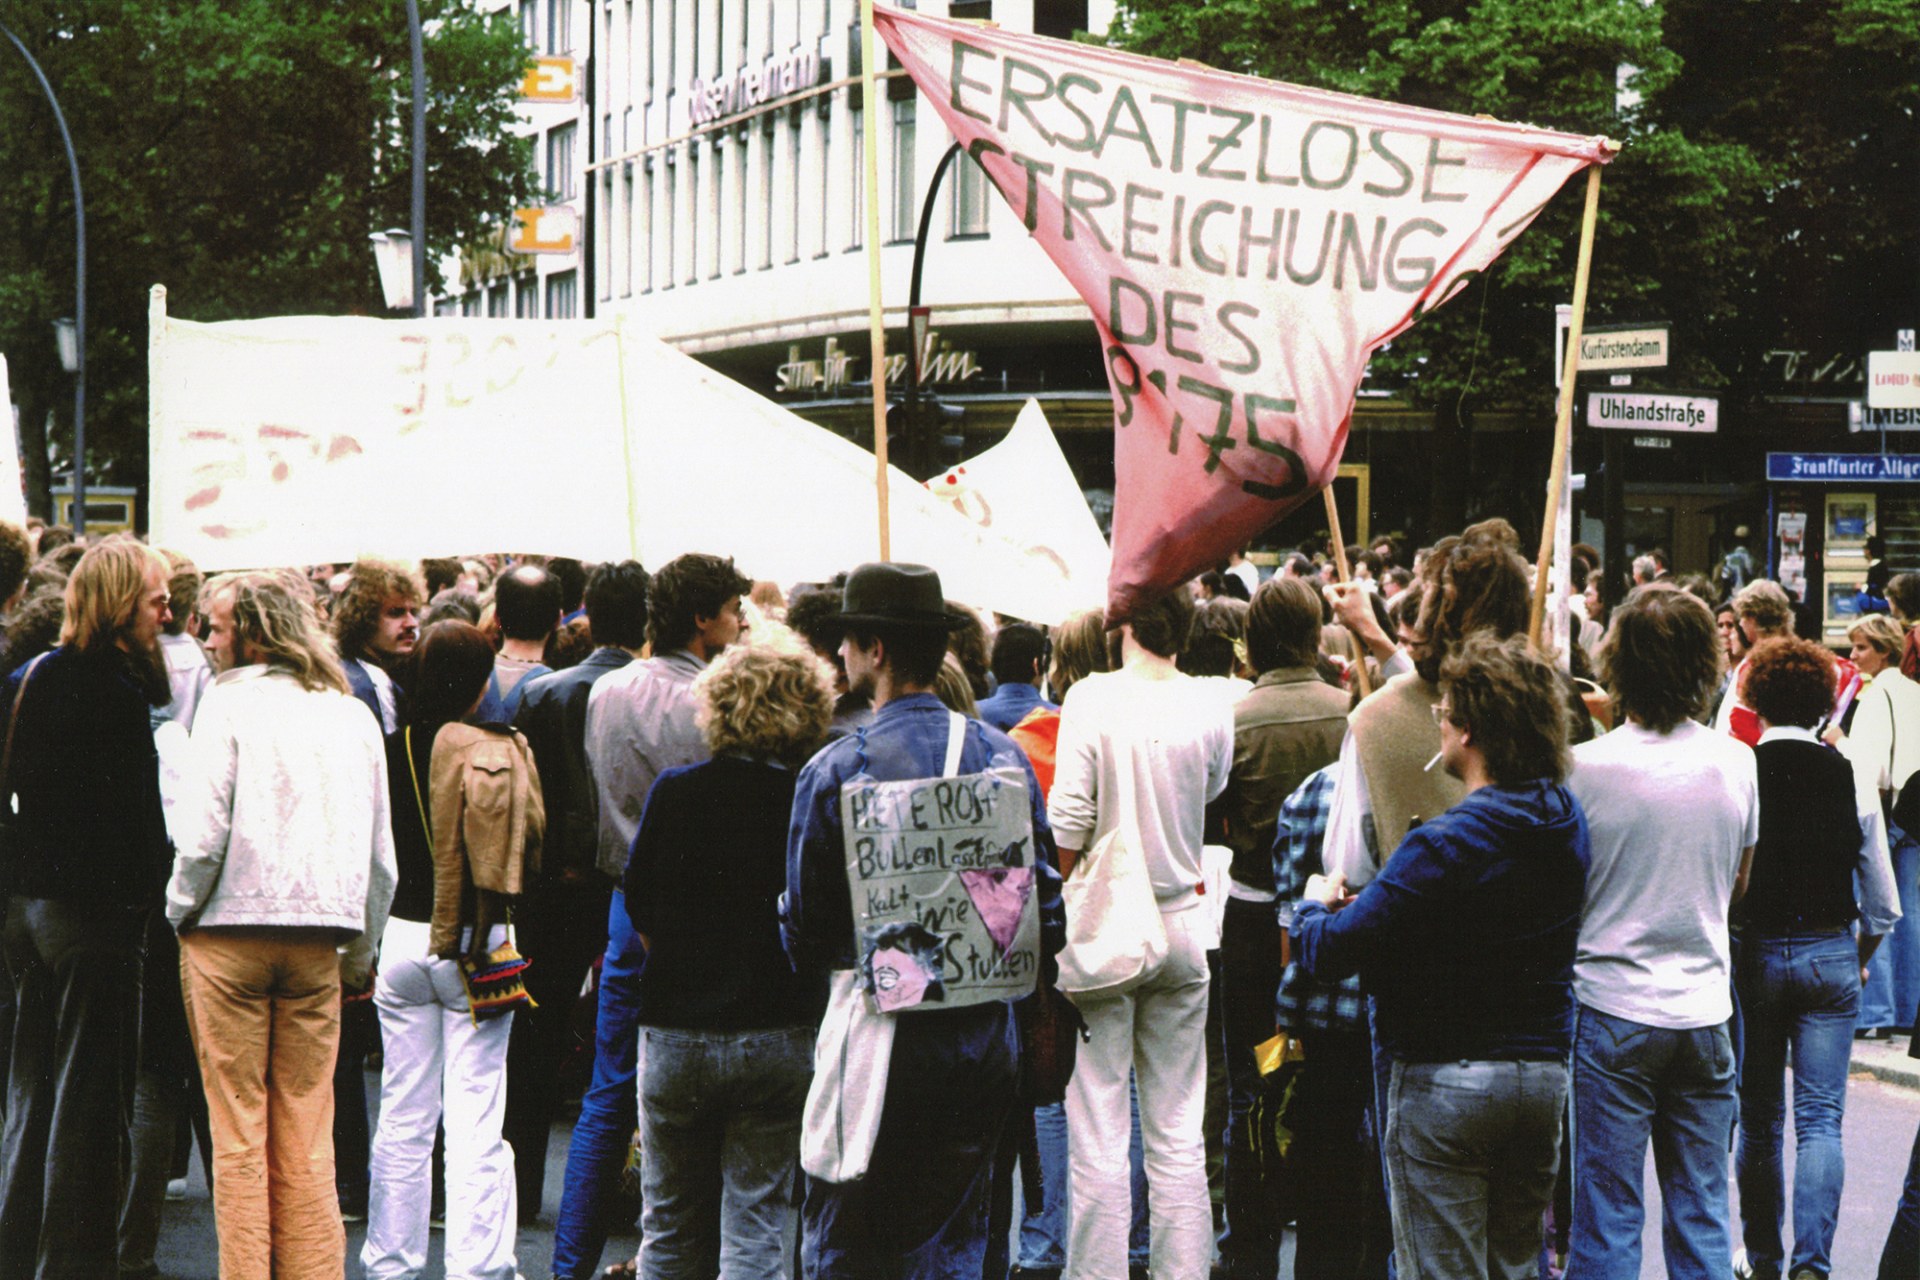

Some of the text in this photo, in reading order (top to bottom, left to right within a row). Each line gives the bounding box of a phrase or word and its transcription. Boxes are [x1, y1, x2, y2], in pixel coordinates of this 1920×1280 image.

[950, 39, 1469, 203] ERSATZLOSE
[513, 207, 572, 251] L
[1110, 276, 1262, 375] DES
[1580, 337, 1661, 361] Kurfürstendamm
[1600, 398, 1706, 428] Uhlandstraße
